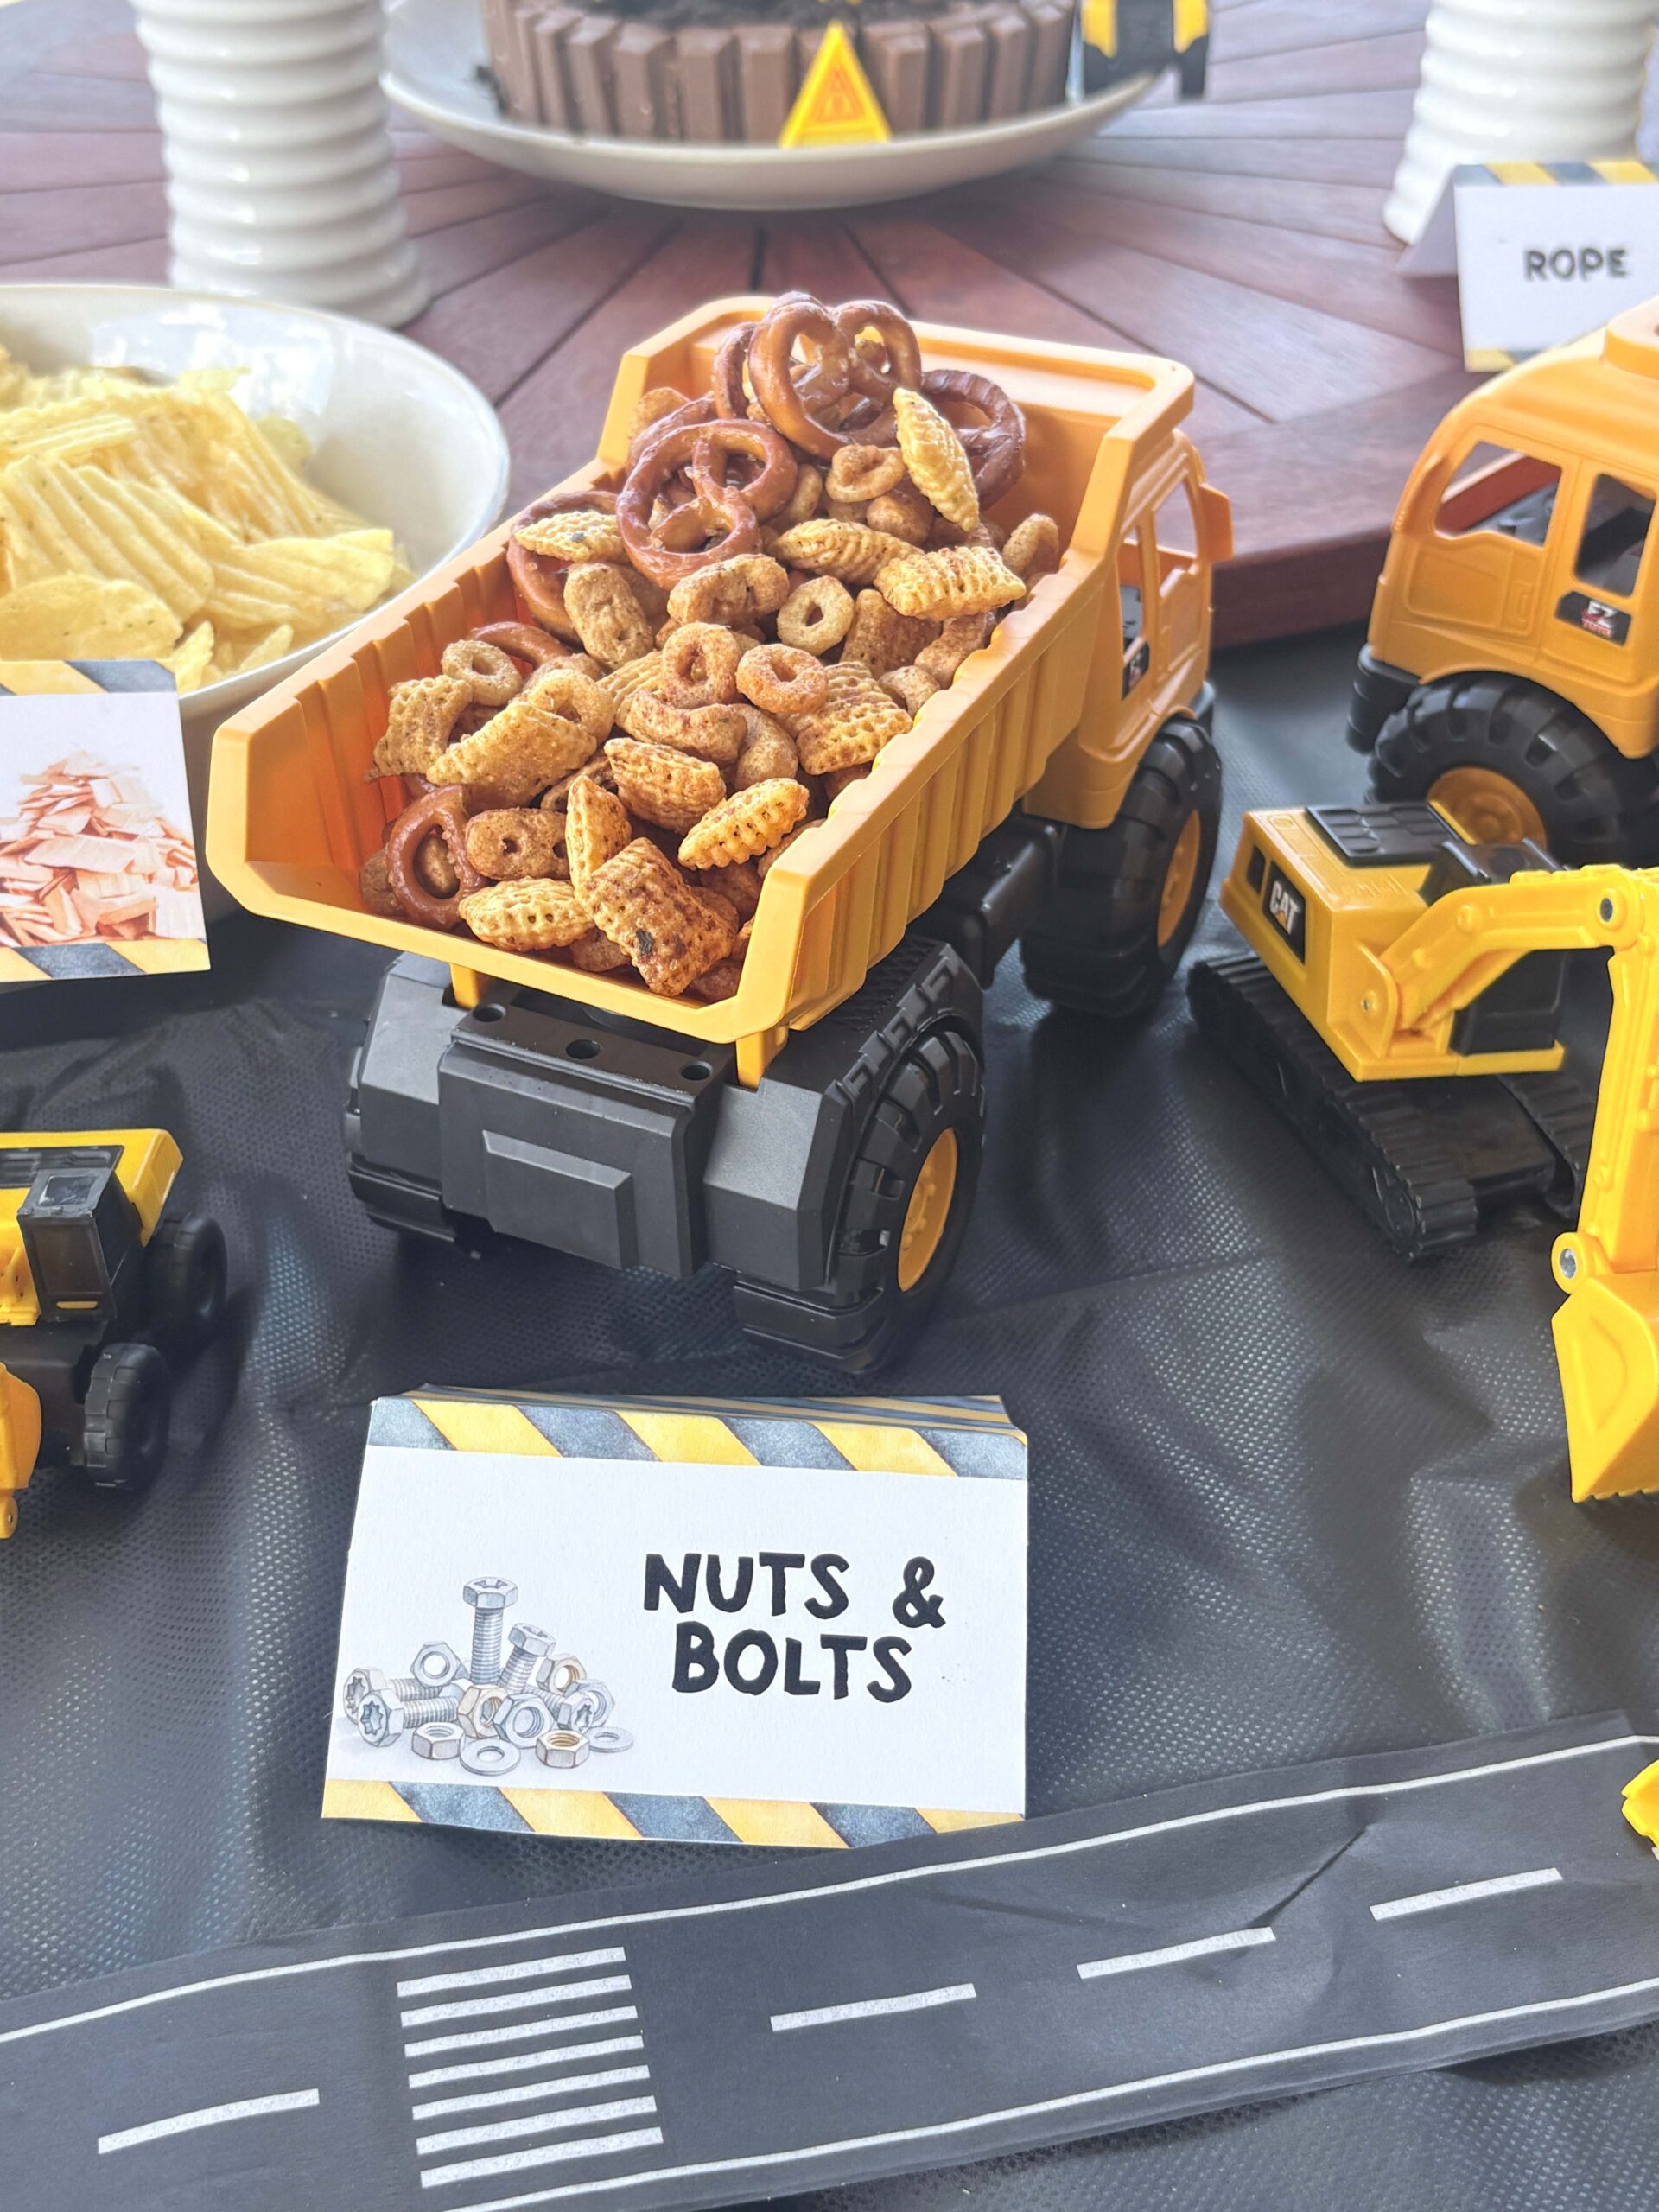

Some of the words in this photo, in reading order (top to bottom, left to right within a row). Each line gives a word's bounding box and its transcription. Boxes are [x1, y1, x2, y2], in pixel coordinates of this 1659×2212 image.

[1524, 248, 1629, 281] ROPE
[1268, 880, 1300, 936] CAT
[644, 1551, 850, 1620] NUTS
[892, 1556, 947, 1629] &
[671, 1620, 913, 1704] BOLTS
